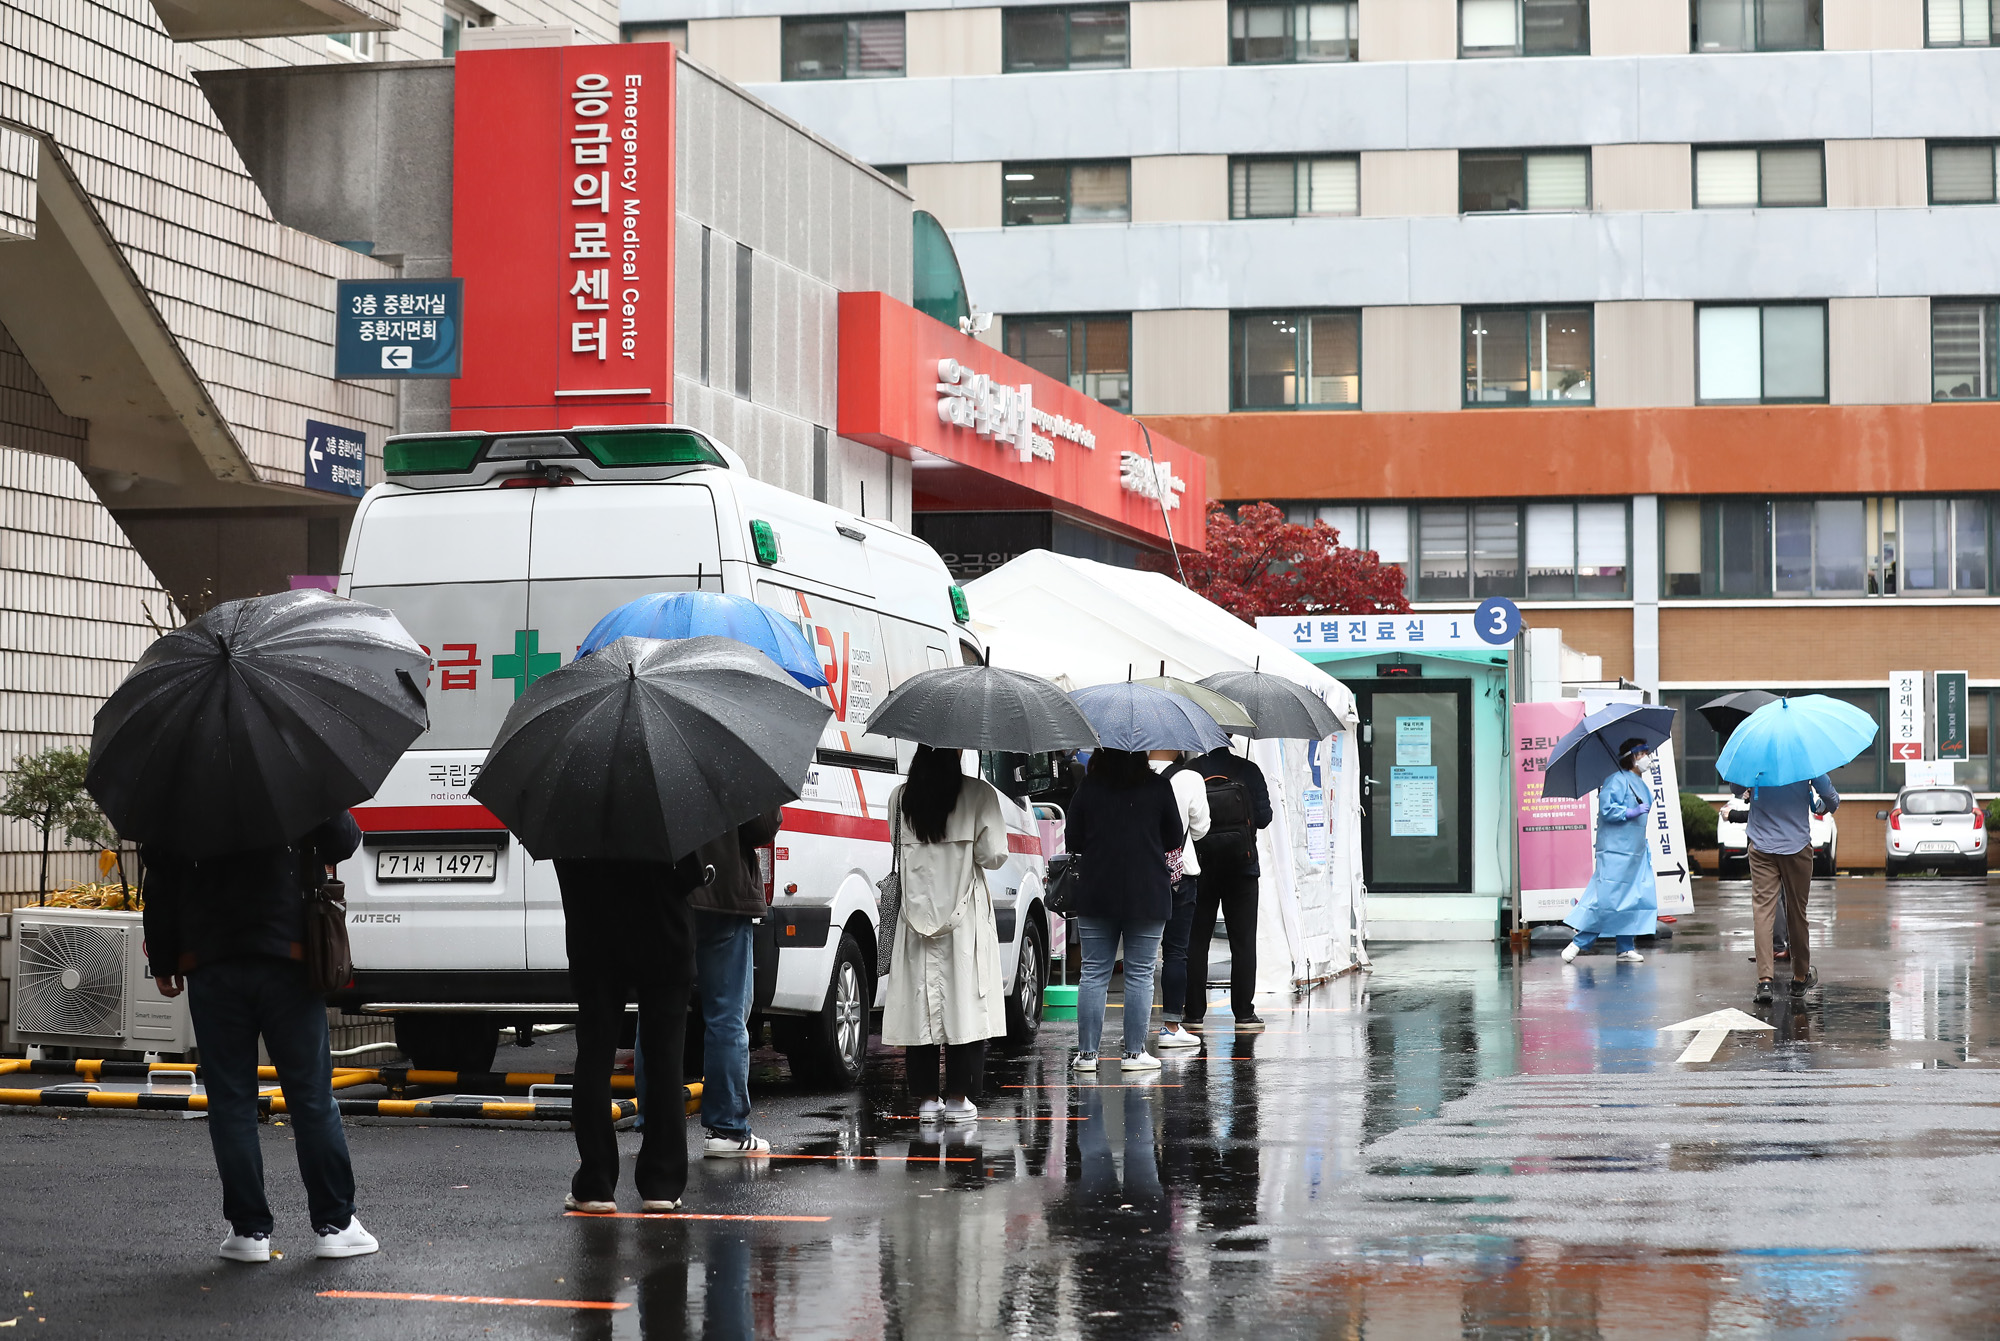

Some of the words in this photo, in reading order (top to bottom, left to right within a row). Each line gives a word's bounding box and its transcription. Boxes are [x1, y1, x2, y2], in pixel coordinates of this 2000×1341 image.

[620, 74, 642, 192] Emergency
[569, 73, 613, 361] 응급의료센터
[621, 199, 641, 281] Medical
[352, 294, 378, 315] 3층
[383, 293, 446, 315] 중환자실
[359, 320, 437, 341] 중환자면회
[621, 288, 640, 360] Center
[325, 436, 337, 455] 3층
[338, 438, 363, 461] 중환자실
[331, 464, 362, 487] 중환자면회
[1293, 619, 1425, 643] 선별진료실
[1450, 621, 1461, 639] 1
[1488, 606, 1509, 636] 3
[418, 644, 482, 691] 급
[851, 663, 861, 677] AND
[1900, 678, 1913, 739] 장례식장
[389, 855, 425, 875] 71서
[435, 854, 485, 874] 1497
[351, 914, 401, 924] AUTECH
